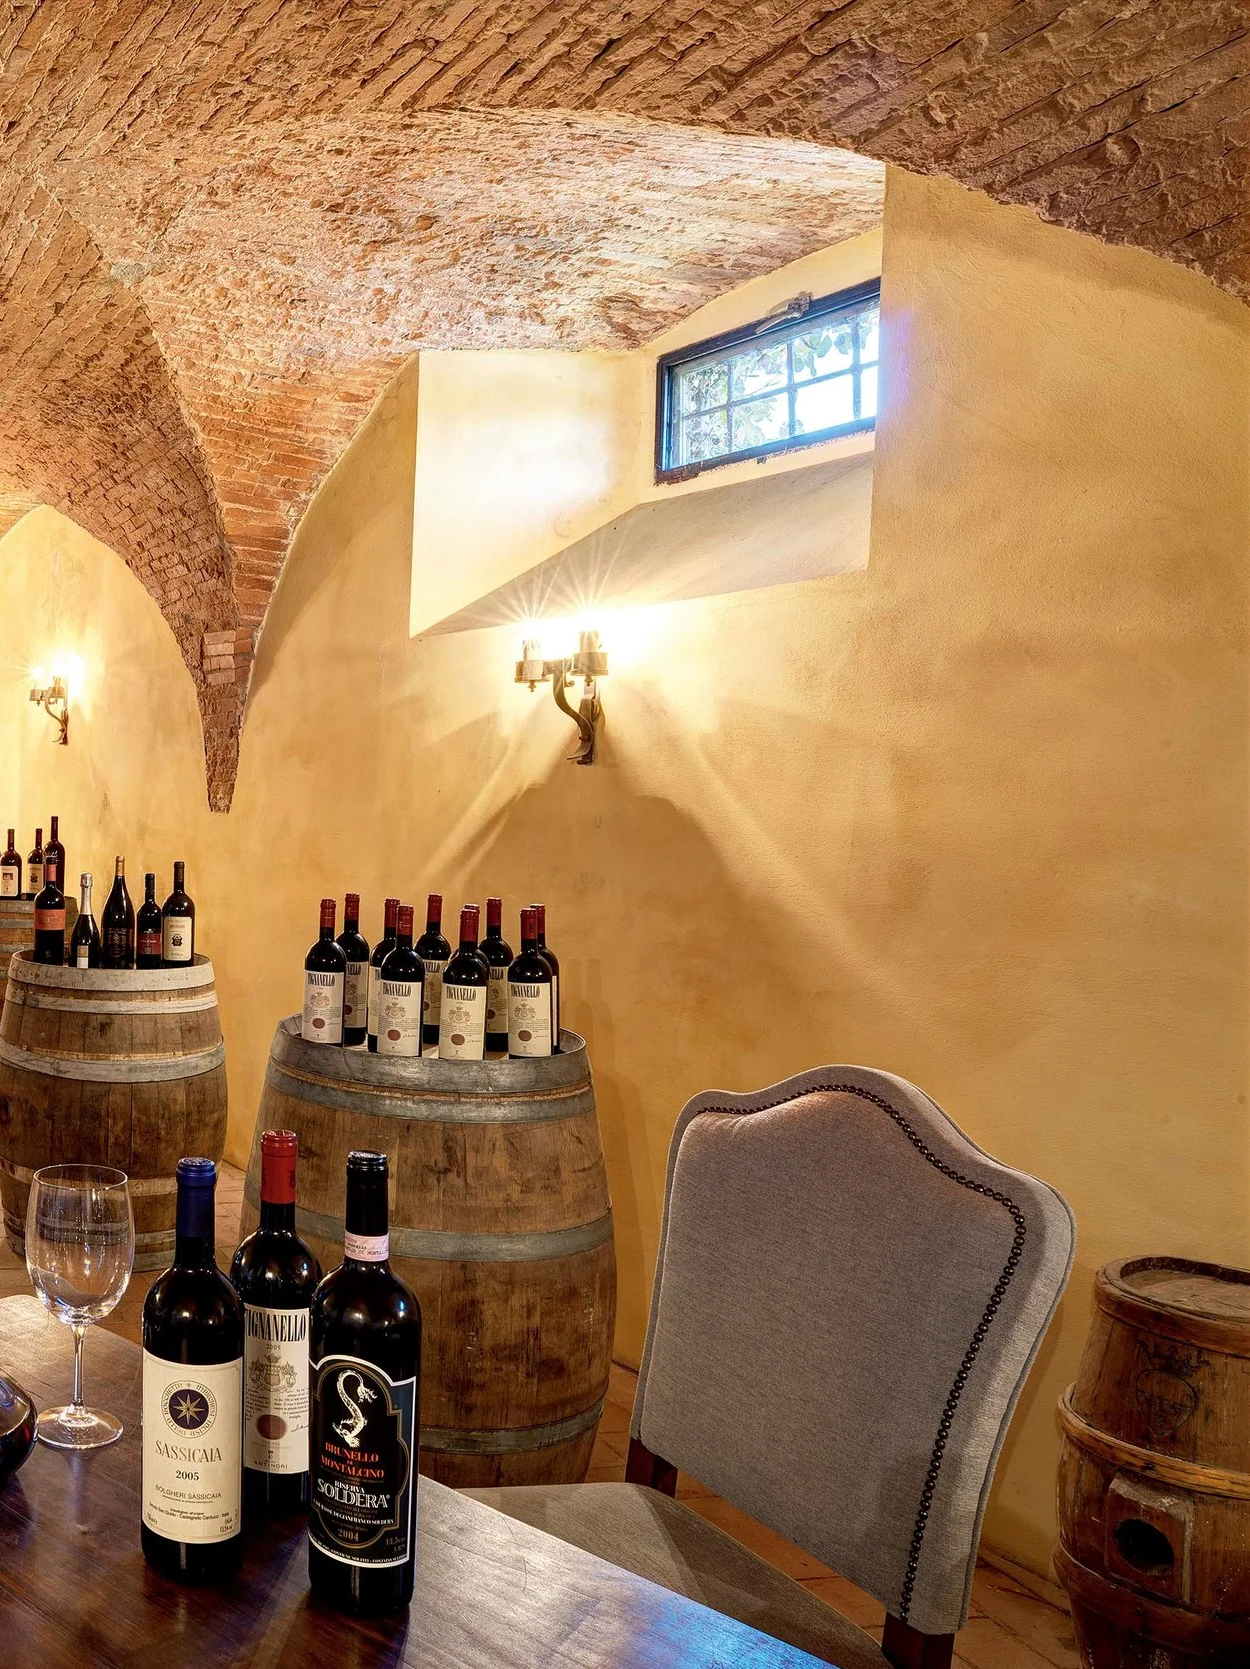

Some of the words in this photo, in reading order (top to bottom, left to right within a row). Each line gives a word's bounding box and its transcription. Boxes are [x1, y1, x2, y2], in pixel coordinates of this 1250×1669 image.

[155, 1439, 223, 1463] SASSICAIA
[325, 1441, 379, 1463] BRUNELLO
[254, 1460, 288, 1469] ANTINORI
[321, 1454, 385, 1478] MONTALCINO
[175, 1469, 200, 1481] 2005
[155, 1484, 186, 1499] BOLGHERI
[187, 1492, 222, 1501] SASSICAIA
[334, 1480, 365, 1494] RISERVA
[337, 1528, 359, 1542] 2004
